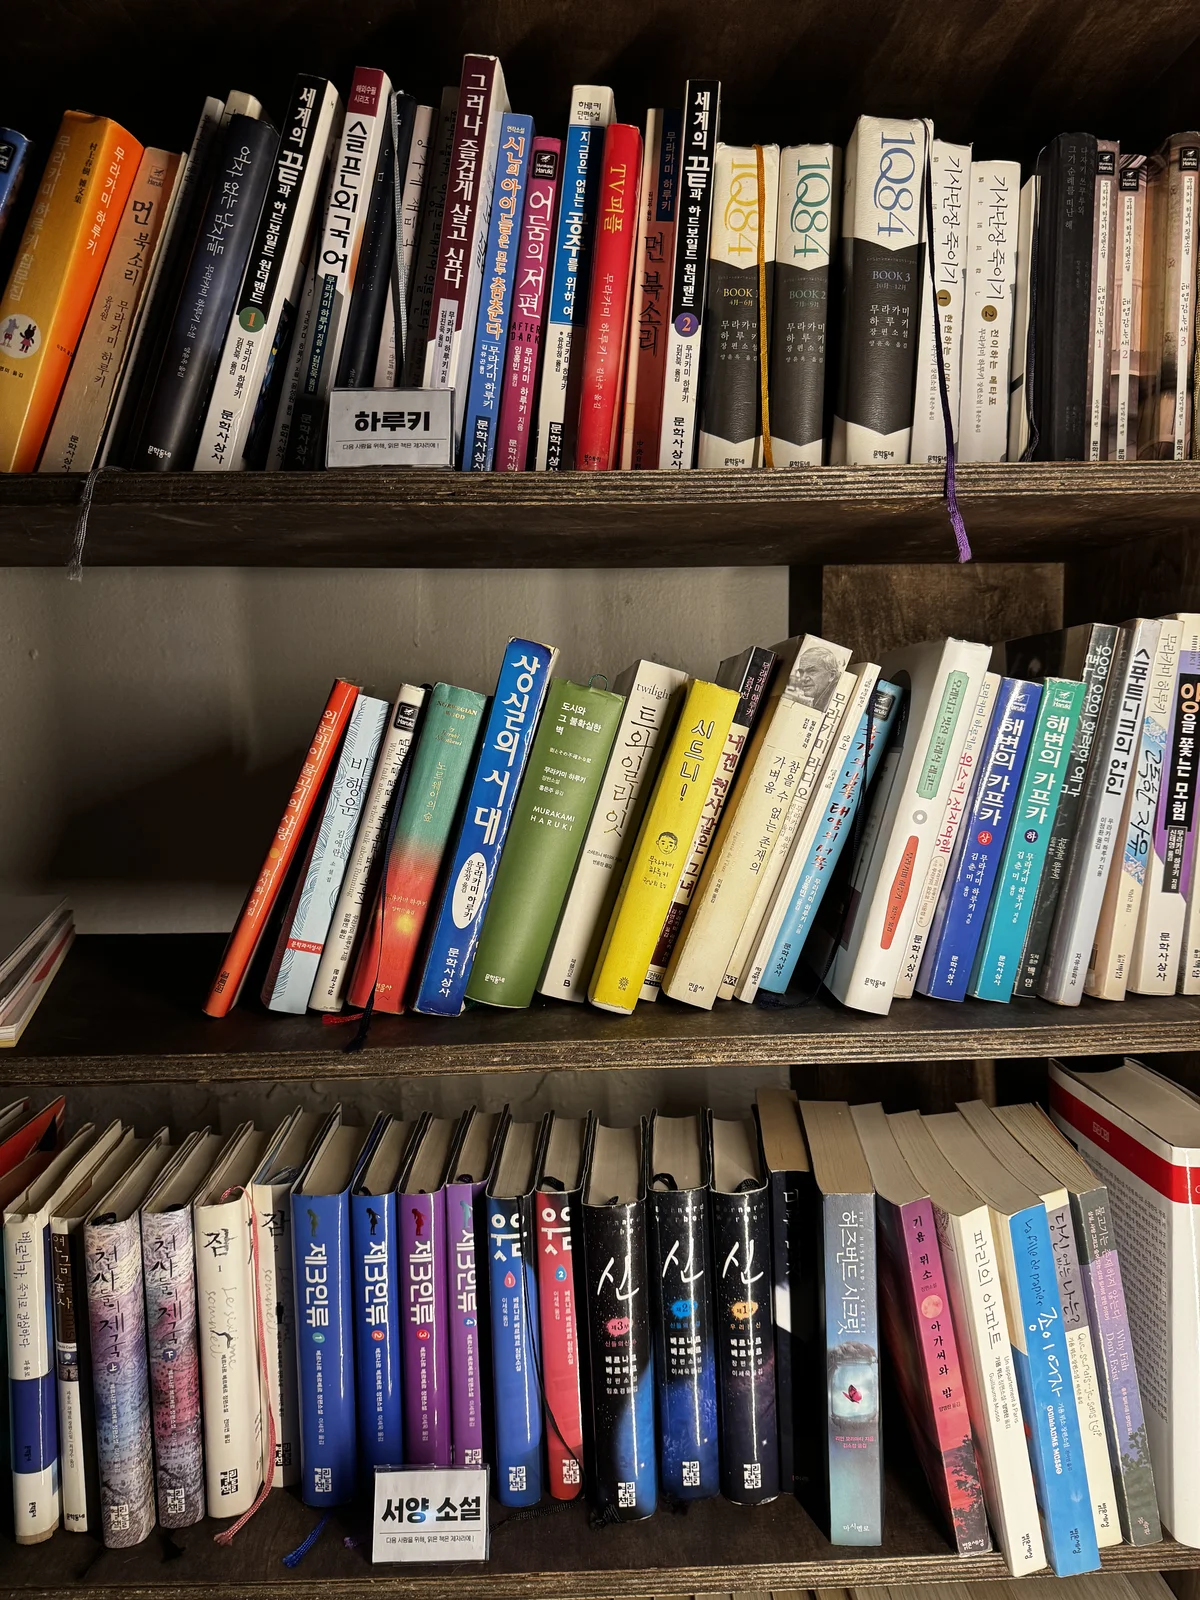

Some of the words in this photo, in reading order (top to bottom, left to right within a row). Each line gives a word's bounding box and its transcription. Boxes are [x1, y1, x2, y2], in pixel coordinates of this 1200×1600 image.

[289, 87, 317, 147] 세계의
[463, 74, 487, 136] 그러나
[577, 111, 600, 121] 단편소설
[578, 101, 602, 111] 하루키
[691, 91, 711, 151] 세계의
[100, 146, 125, 208] 무라카미
[276, 150, 304, 198] 끝과
[453, 138, 483, 201] 즐겁게
[684, 155, 711, 201] 끝과
[873, 131, 915, 237] 1Q84
[132, 200, 153, 225] 먼
[261, 200, 288, 257] 하드보일드
[446, 203, 472, 241] 살고
[790, 157, 831, 258] 1Q84
[86, 210, 106, 256] 하루키
[644, 231, 665, 263] 먼
[684, 205, 702, 260] 하드보일드
[124, 232, 150, 286] 북소리
[443, 247, 464, 289] 싶다
[872, 270, 903, 281] BOOK
[904, 272, 911, 282] 3
[251, 258, 273, 303] 원더랜드
[680, 263, 697, 307] 원더랜드
[723, 288, 753, 297] BOOK
[789, 290, 818, 299] BOOK
[819, 291, 826, 300] 2
[107, 299, 129, 349] 무라카미
[638, 271, 666, 356] 북소리
[681, 317, 691, 331] 2
[786, 322, 825, 332] 무라카미
[870, 305, 910, 316] 무라카미
[93, 351, 114, 388] 하루키
[241, 340, 254, 373] 무라카미
[485, 346, 500, 381] 무라카미
[522, 347, 533, 384] 무라카미
[684, 344, 692, 377] 무라카미
[233, 374, 246, 399] 하루키
[482, 382, 496, 409] 하루키
[518, 387, 529, 415] 하루키
[681, 379, 690, 403] 하루키
[212, 409, 233, 464] 문학사상사
[355, 411, 430, 432] 하루키
[671, 417, 685, 469] 문학사상사
[1157, 633, 1177, 678] 무라카미
[493, 655, 540, 767] 상실의
[561, 702, 587, 716] 도시와
[636, 682, 672, 700] twilight
[1114, 649, 1150, 755] 스푸트니크의
[1151, 680, 1170, 715] 하루키
[310, 710, 337, 761] 외눈박이
[555, 725, 564, 735] 벽
[558, 714, 566, 723] 그
[569, 716, 601, 734] 불확실한
[815, 693, 845, 755] 무라카미
[992, 718, 1024, 771] 해변의
[1038, 715, 1069, 769] 해변의
[543, 766, 568, 778] 무라카미
[568, 772, 587, 783] 하루키
[604, 706, 659, 837] 트와일라잇
[679, 719, 716, 801] 시드니!
[764, 756, 786, 794] 가벼움
[784, 760, 800, 787] 참을
[795, 757, 821, 801] 라디오
[1105, 759, 1128, 795] 연인
[1136, 749, 1163, 806] 고독한
[287, 763, 315, 812] 물고기의
[427, 762, 447, 810] 노르웨이의
[473, 766, 510, 846] 시대
[776, 790, 789, 803] 수
[979, 773, 1010, 826] 카프카
[1024, 772, 1056, 825] 카프카
[277, 815, 297, 841] 사랑
[423, 811, 433, 822] 숲
[530, 815, 573, 831] HARUKI
[532, 806, 575, 822] MURAKAMI
[765, 807, 782, 832] 없는
[1127, 810, 1150, 857] 자유
[749, 836, 771, 874] 존재의
[980, 833, 990, 843] 상
[1026, 831, 1037, 842] 하
[470, 861, 485, 895] 무라카미
[975, 854, 988, 886] 무라카미
[1020, 852, 1034, 885] 무라카미
[463, 895, 477, 921] 하루키
[968, 888, 980, 911] 하루키
[1015, 886, 1026, 910] 하루키
[438, 947, 460, 997] 문학사상사
[774, 942, 792, 977] 문학사상사
[904, 935, 923, 982] 문학사상사
[1156, 932, 1170, 981] 문학사상사
[484, 973, 505, 985] 문학동네
[864, 977, 886, 988] 문학동네
[202, 1228, 238, 1258] 잠
[260, 1210, 290, 1237] 잠
[1050, 1213, 1069, 1256] 당신
[662, 1237, 704, 1283] 신
[722, 1239, 764, 1284] 신
[836, 1210, 859, 1280] 허즈번드
[912, 1215, 926, 1243] 기욤
[919, 1254, 933, 1280] 뮈소
[974, 1229, 994, 1287] 파리의
[1056, 1252, 1070, 1277] 없는
[53, 1234, 72, 1310] 연금술사
[92, 1245, 120, 1313] 천사들의
[150, 1234, 177, 1301] 천사들의
[304, 1242, 330, 1328] 제3인류
[363, 1241, 388, 1326] 제3인류
[409, 1240, 433, 1325] 제3인류
[597, 1257, 639, 1300] 신
[157, 1301, 183, 1344] 제국
[837, 1284, 860, 1335] 시크릿
[983, 1293, 1002, 1349] 아파트
[1063, 1279, 1080, 1324] 나는?
[99, 1315, 125, 1358] 제국
[669, 1336, 702, 1345] 베르나르
[670, 1346, 702, 1356] 베르베르
[1028, 1307, 1058, 1352] 종이
[1047, 1353, 1065, 1398] 여자
[1116, 1329, 1124, 1346] Why
[1120, 1350, 1129, 1372] Fish
[605, 1355, 637, 1364] 베르나르
[605, 1366, 637, 1375] 베르베르
[931, 1321, 949, 1376] 아가씨와
[941, 1386, 952, 1399] 밤
[1110, 1356, 1120, 1382] Exist
[66, 1513, 85, 1522] 문학동네
[382, 1497, 429, 1523] 서양
[435, 1496, 480, 1521] 소설
[843, 1523, 870, 1533] 마시멜로
